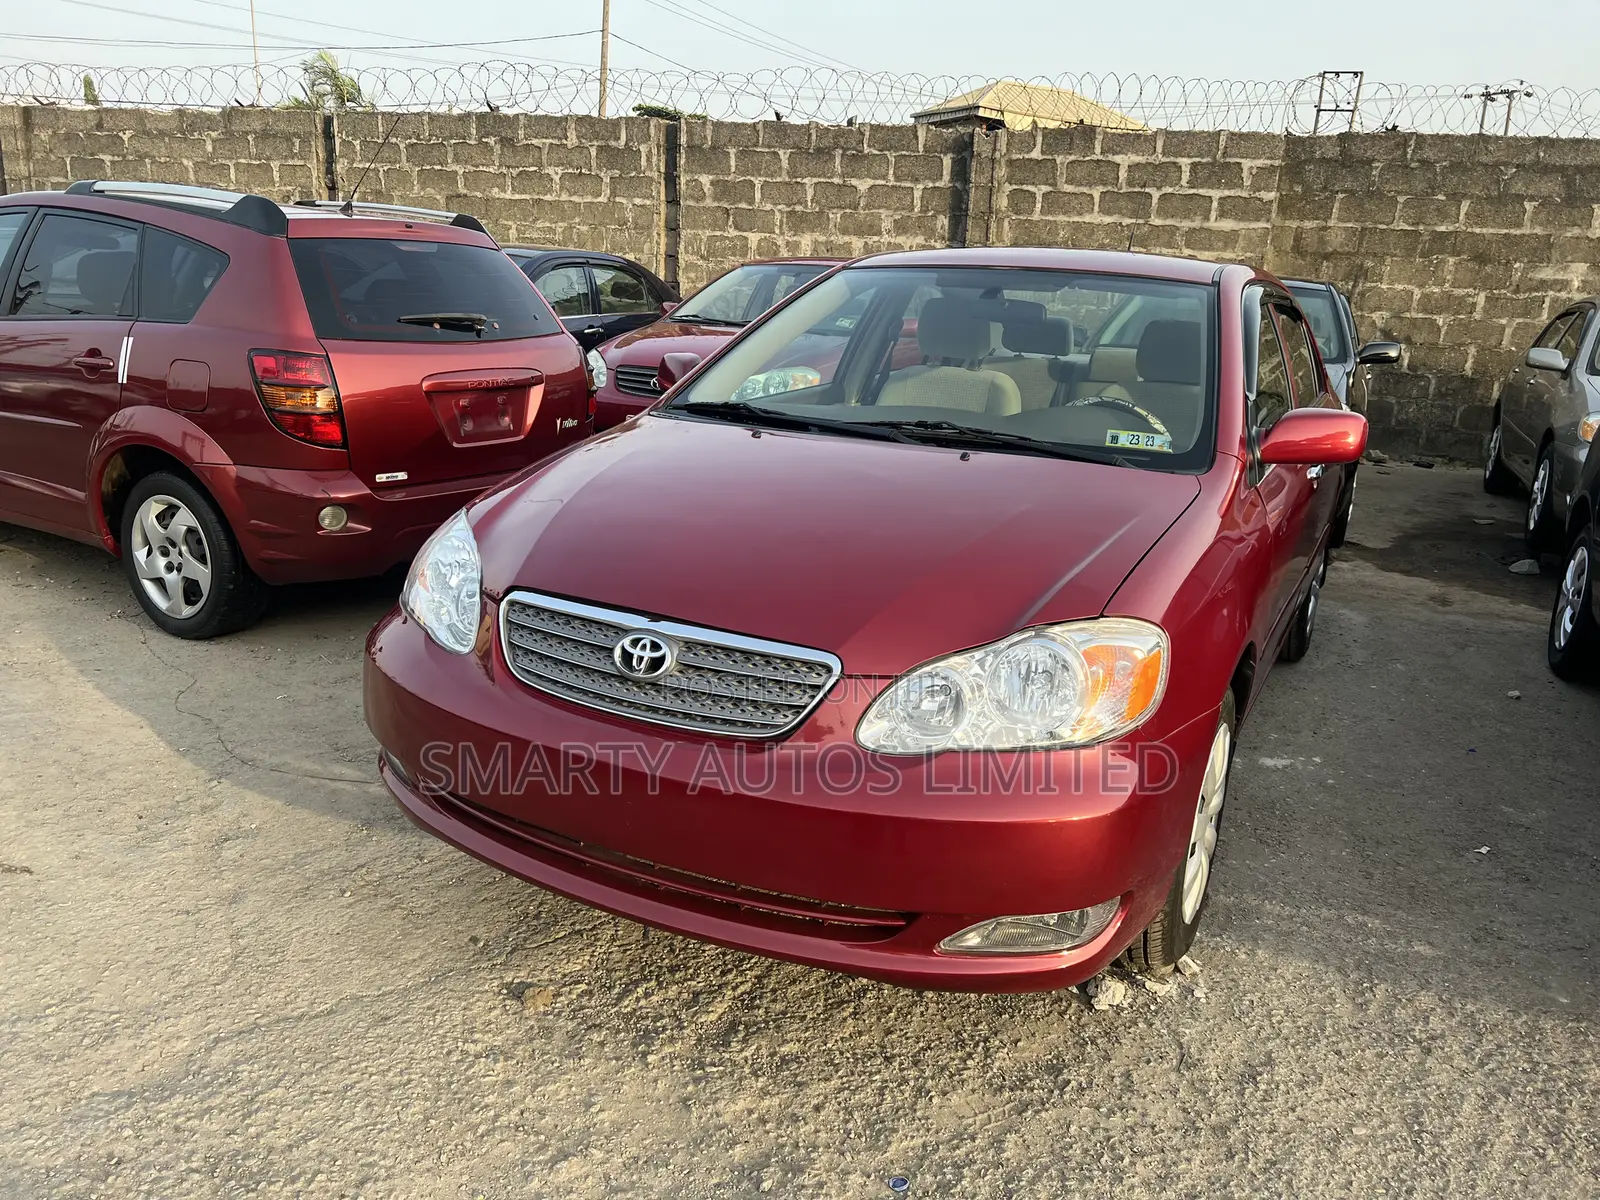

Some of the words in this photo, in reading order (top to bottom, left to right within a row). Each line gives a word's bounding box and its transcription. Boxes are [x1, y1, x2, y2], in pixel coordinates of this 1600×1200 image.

[467, 377, 514, 388] PONTIAC
[1129, 433, 1140, 446] 23
[1145, 435, 1155, 447] 23
